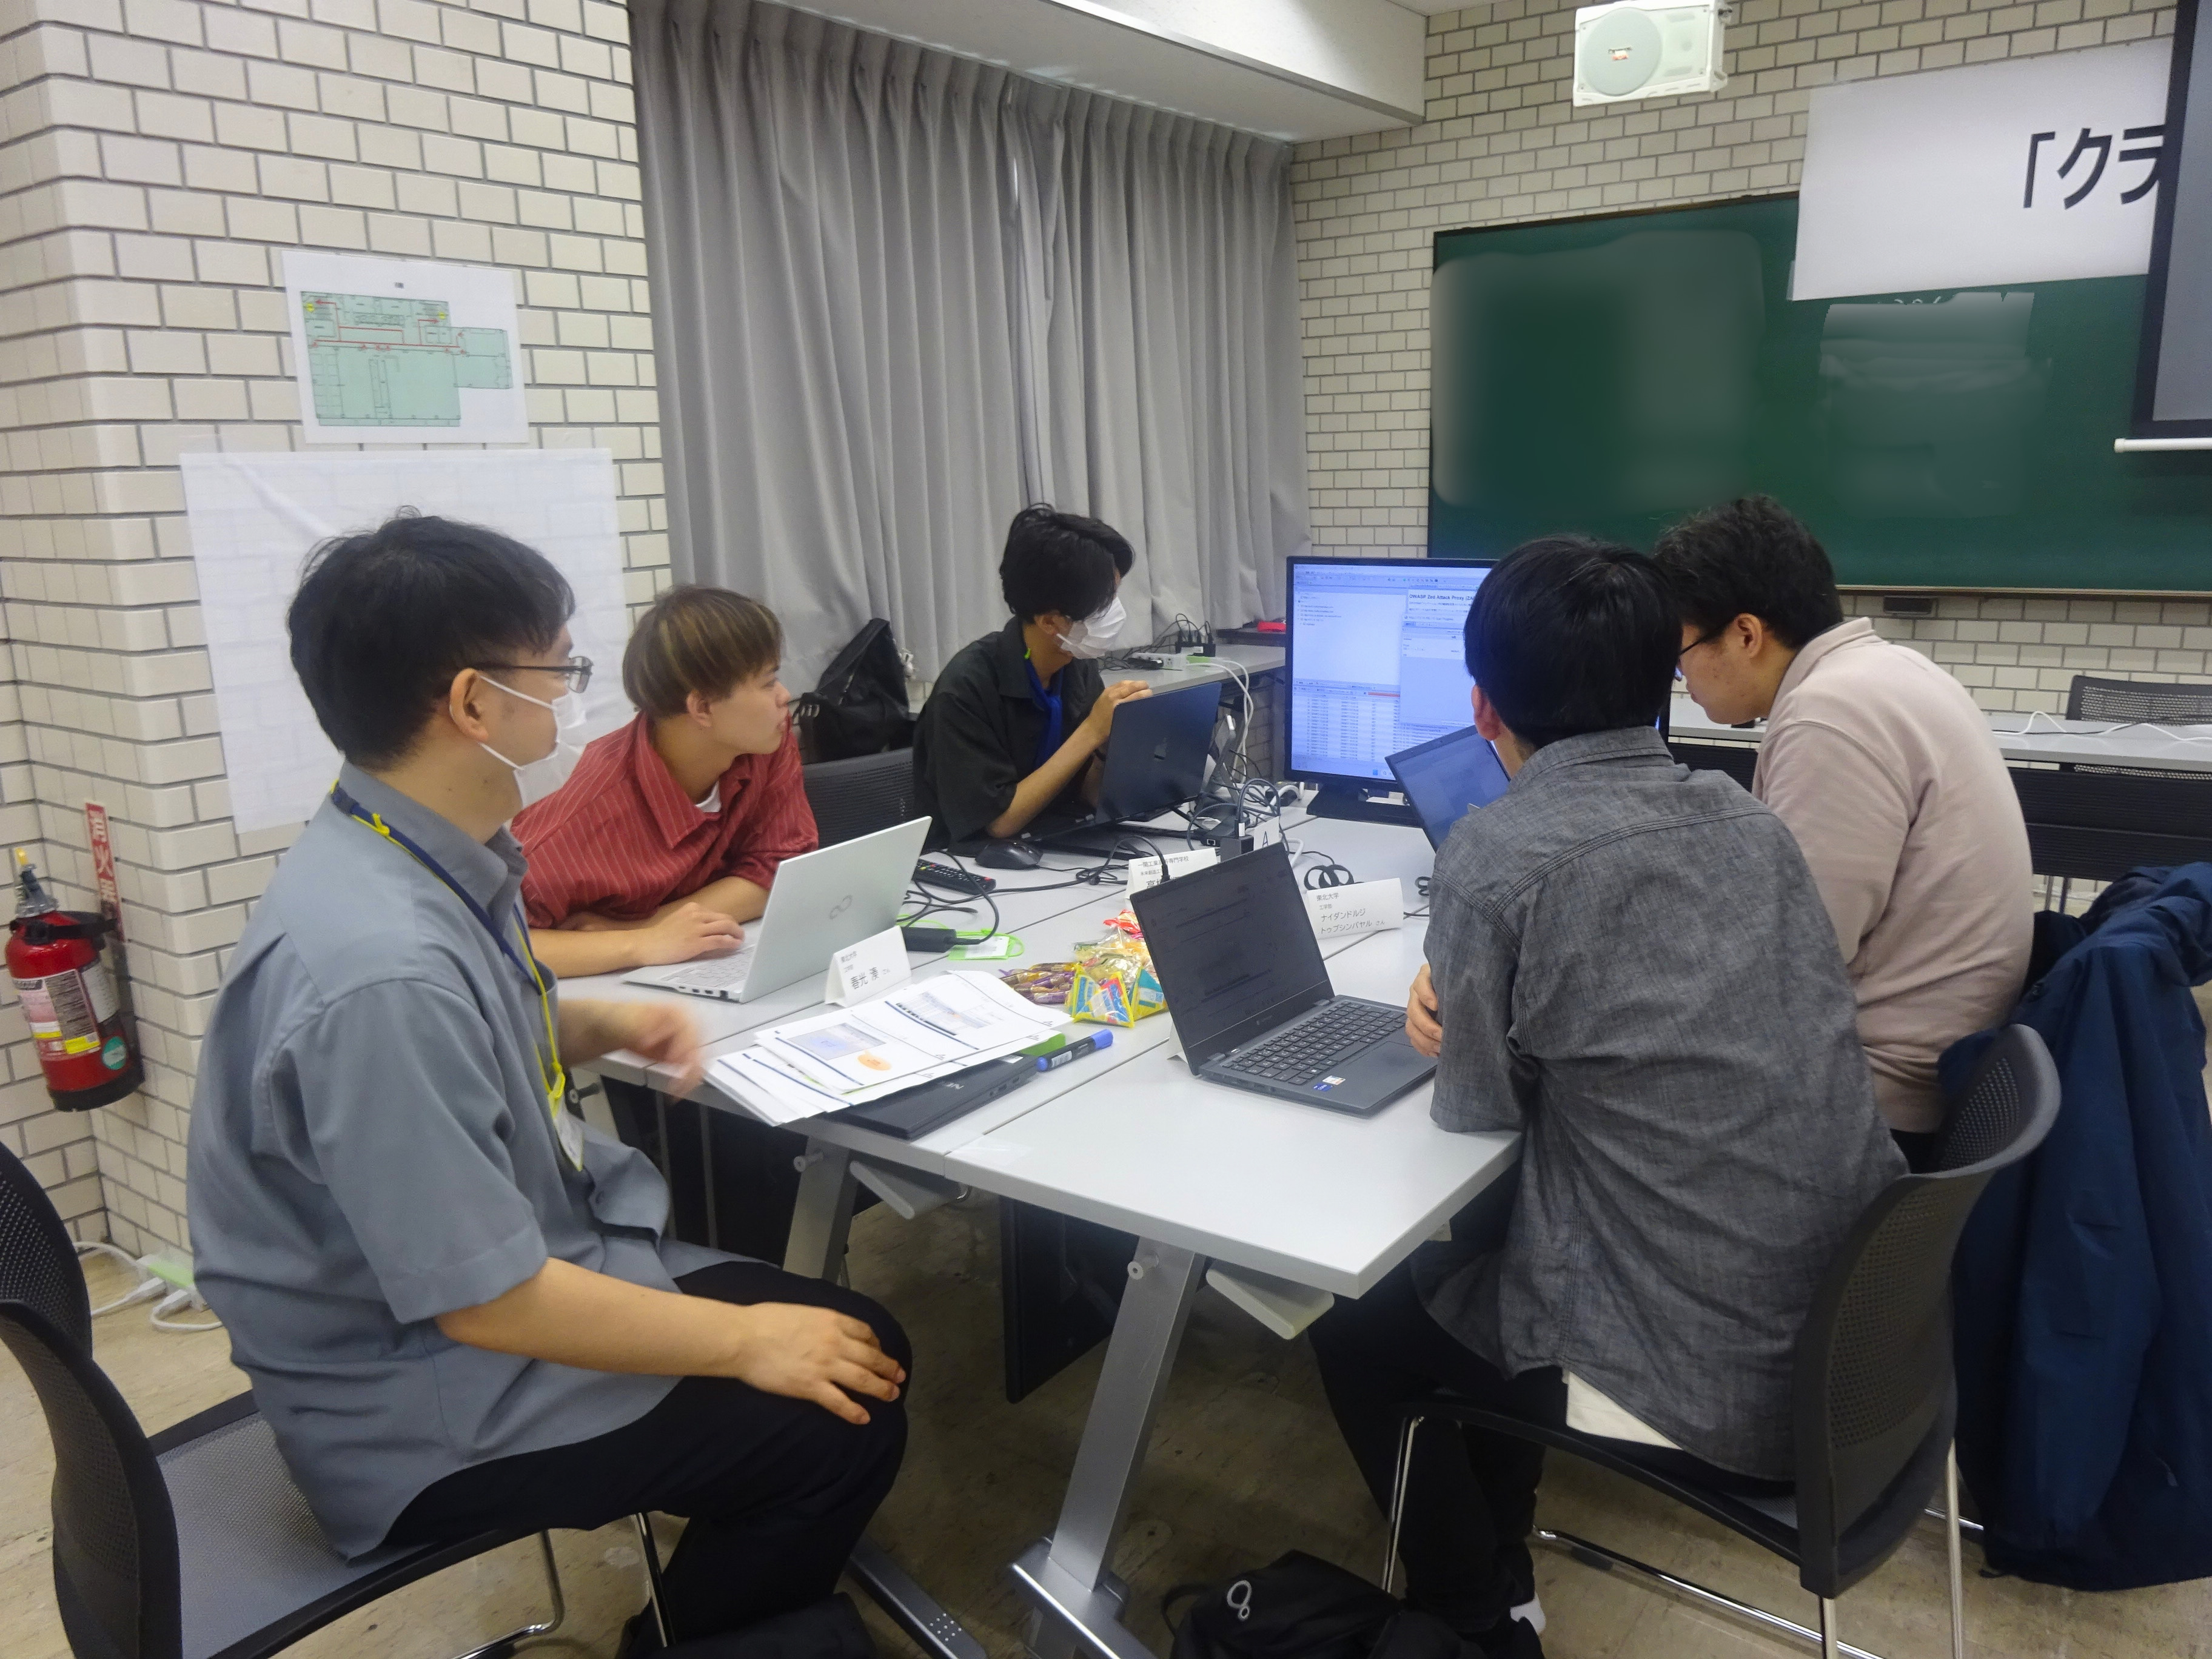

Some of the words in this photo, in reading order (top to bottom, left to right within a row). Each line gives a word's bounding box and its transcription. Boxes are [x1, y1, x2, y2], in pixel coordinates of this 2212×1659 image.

[1262, 831, 1269, 848] A
[1316, 893, 1339, 902] 東北大学
[1321, 908, 1366, 922] ナイダンドルジ
